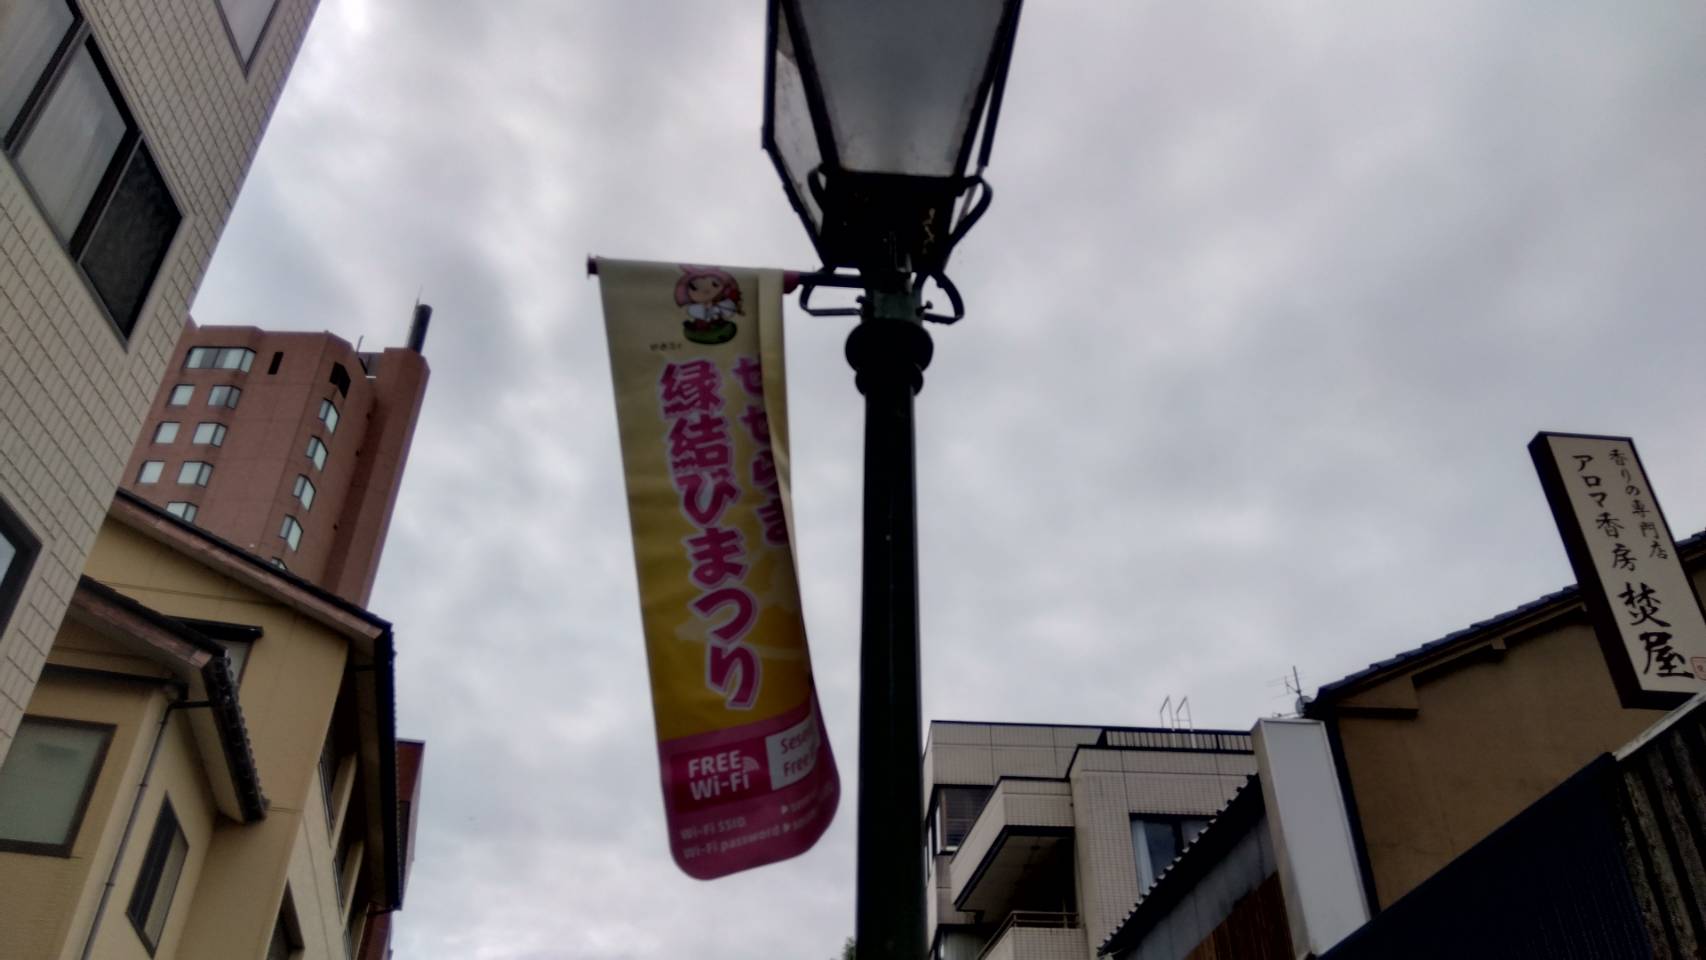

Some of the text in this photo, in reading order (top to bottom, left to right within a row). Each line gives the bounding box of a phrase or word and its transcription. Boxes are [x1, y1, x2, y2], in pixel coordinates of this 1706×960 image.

[1609, 449, 1668, 560] 香りの専門店
[659, 359, 758, 706] 縁結びまつり
[1572, 453, 1695, 679] アロマ香房 焚屋
[688, 750, 742, 779] FREE
[690, 772, 750, 801] Wi-Fi
[681, 822, 715, 840] Wi-Fi
[683, 824, 780, 859] Wi-Fi password
